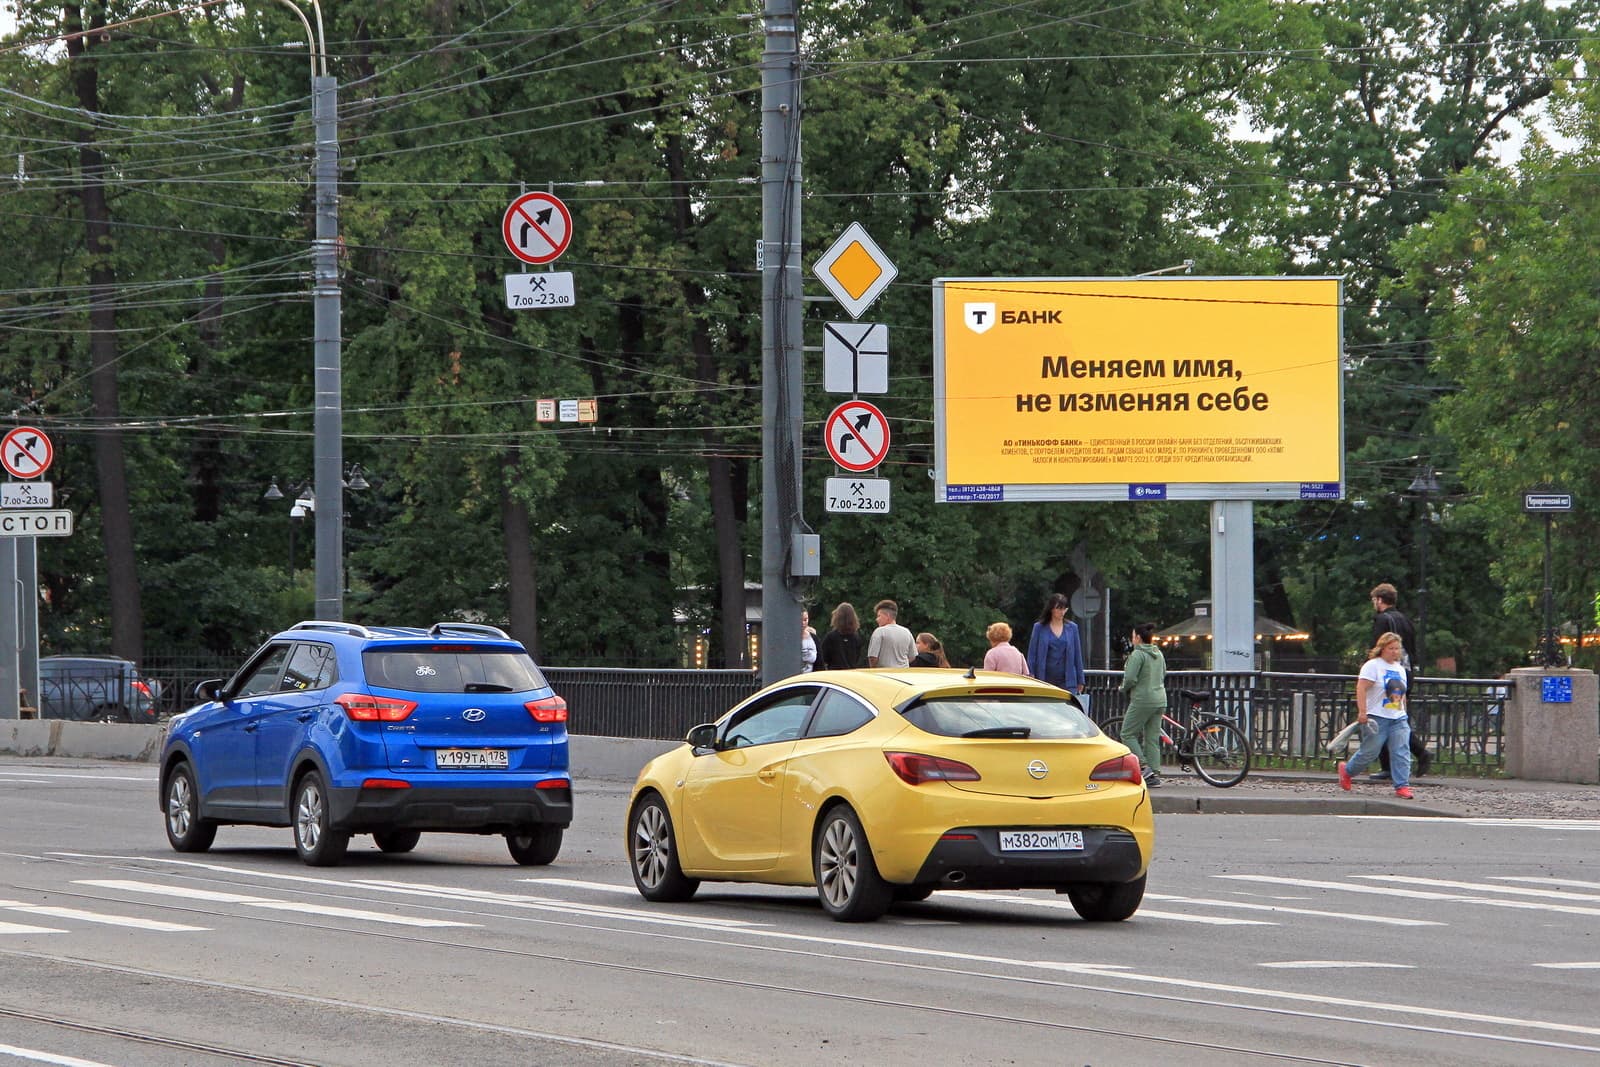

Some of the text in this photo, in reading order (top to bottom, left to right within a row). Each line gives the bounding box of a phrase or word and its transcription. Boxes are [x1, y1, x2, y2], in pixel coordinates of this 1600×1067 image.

[513, 292, 569, 306] 7.00-23.00
[1001, 310, 1063, 324] БАНК
[1041, 356, 1242, 382] Меняем имя,
[1016, 386, 1269, 412] не изменяя себе
[3, 496, 49, 505] 7.00-23.00
[829, 497, 886, 509] 7.00-23.00
[2, 516, 66, 531] СТОП
[488, 751, 505, 761] 178
[1060, 832, 1079, 843] 178
